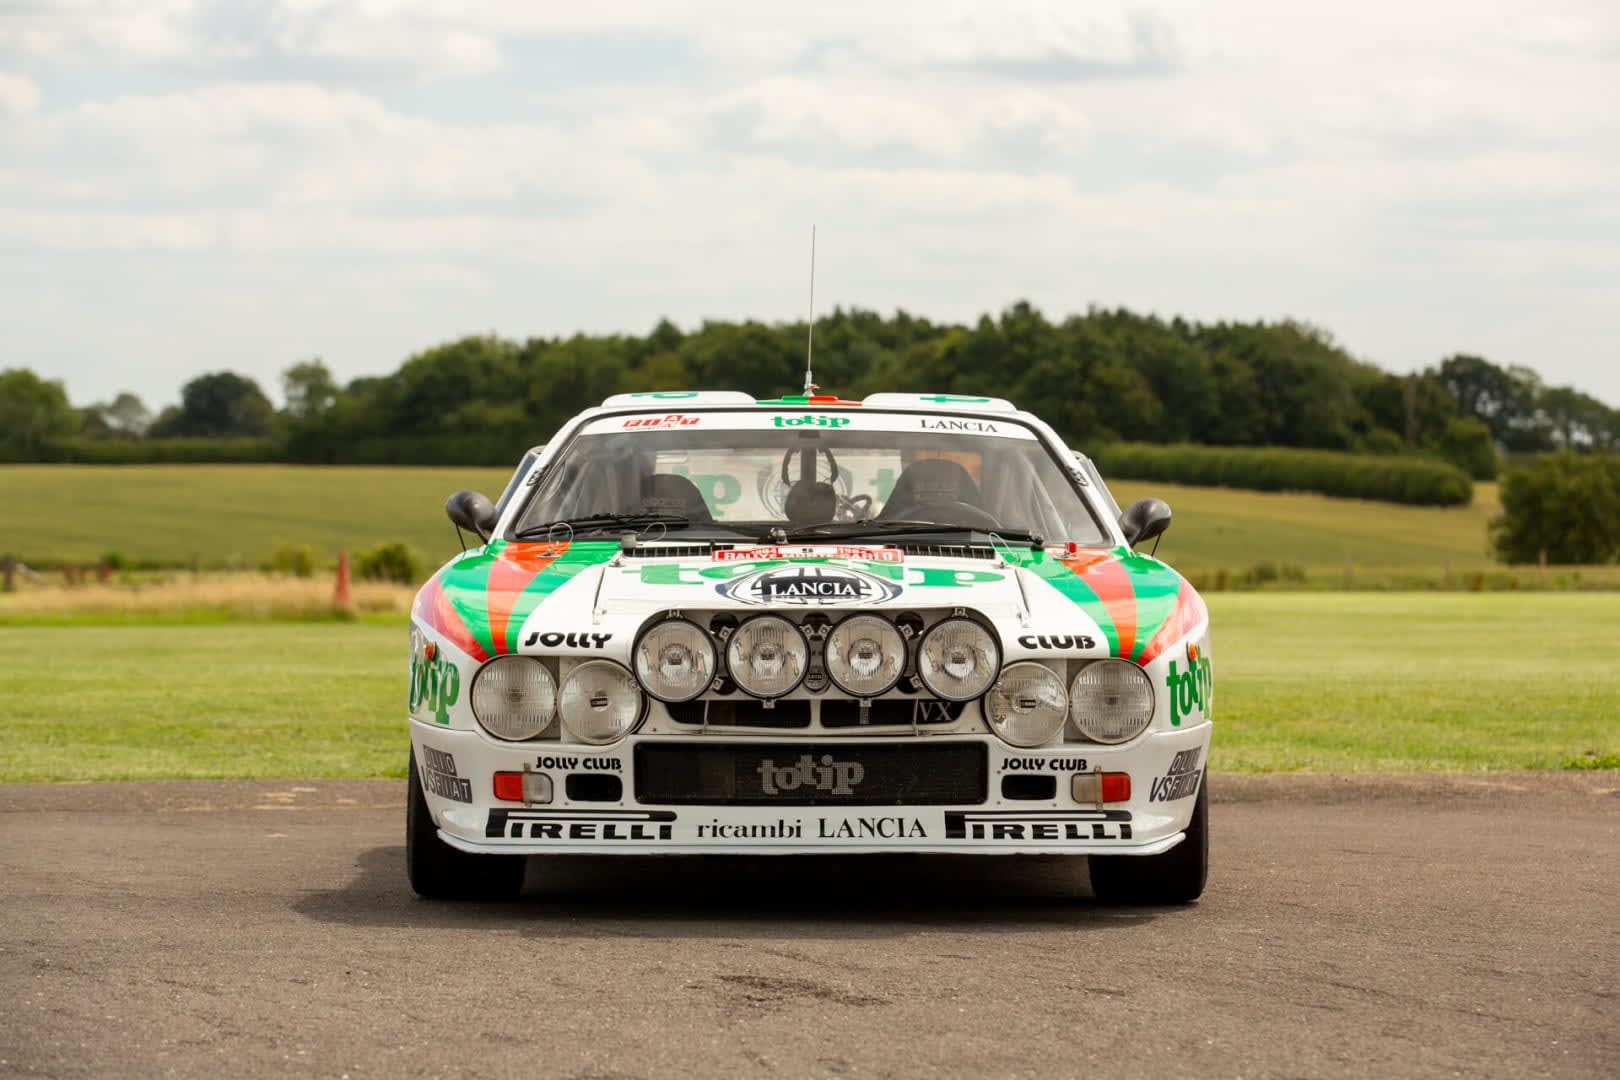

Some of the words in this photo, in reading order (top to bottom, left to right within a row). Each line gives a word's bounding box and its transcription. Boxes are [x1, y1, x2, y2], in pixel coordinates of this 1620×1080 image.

[769, 414, 851, 429] totip
[919, 418, 998, 433] LANCIA
[770, 582, 857, 596] LANCIA
[524, 631, 613, 649] JOLLY
[1018, 635, 1096, 650] CLUB
[919, 702, 952, 721] VX
[535, 756, 579, 770] JOLLY
[582, 757, 622, 770] CLUB
[1001, 758, 1046, 771] JOLLY
[1049, 758, 1088, 772] CLUB
[756, 754, 865, 795] totip
[486, 808, 677, 840] PIRELLI
[696, 819, 801, 839] ricambi
[818, 817, 928, 838] LANCIA
[944, 810, 1133, 840] PIRELLI
